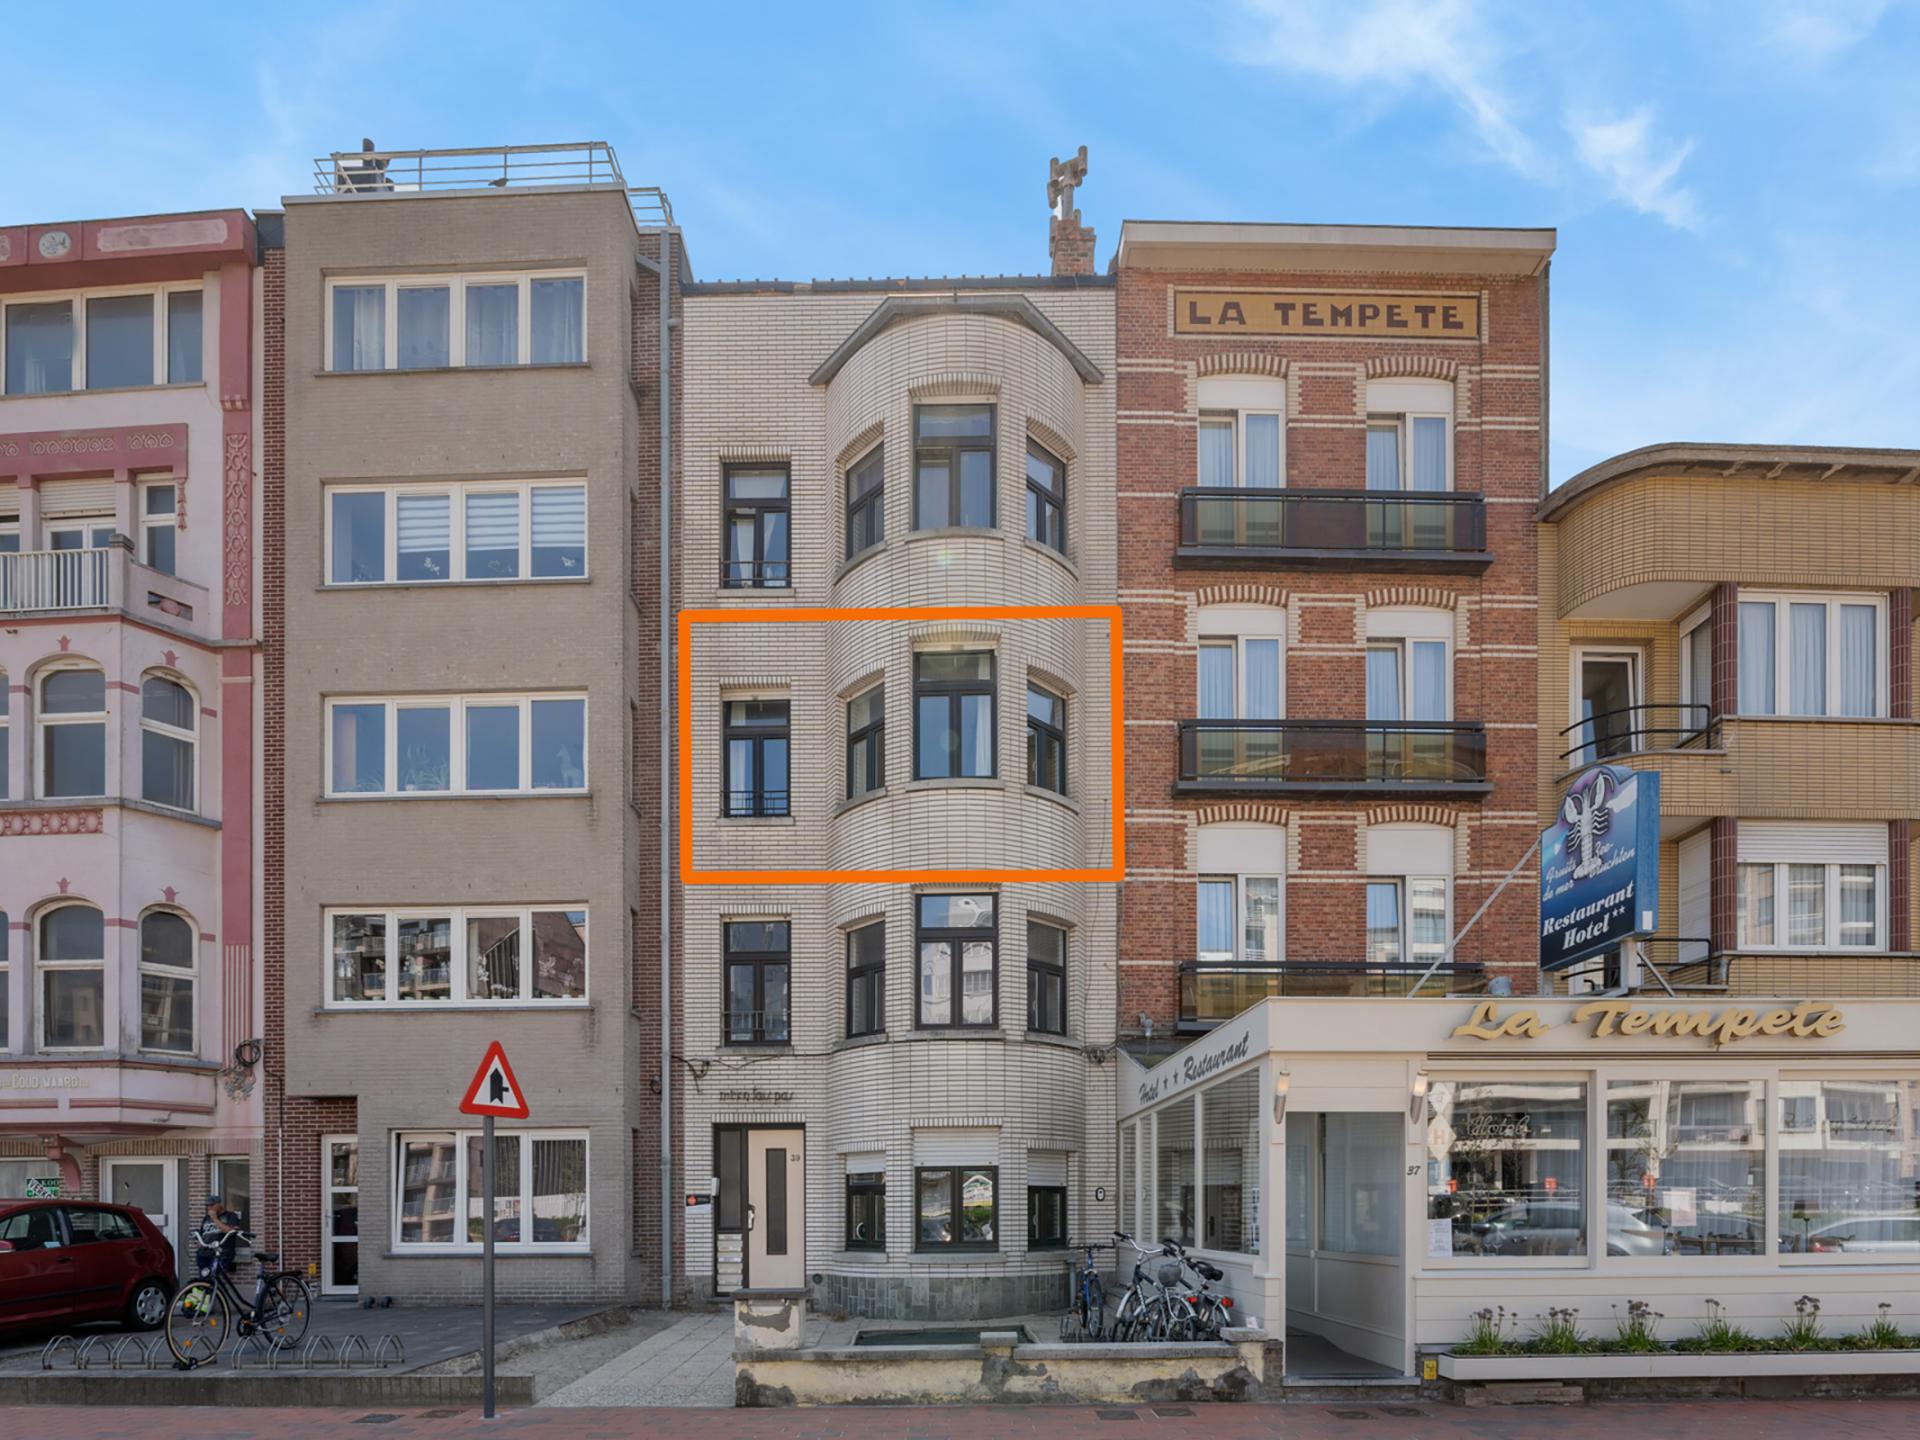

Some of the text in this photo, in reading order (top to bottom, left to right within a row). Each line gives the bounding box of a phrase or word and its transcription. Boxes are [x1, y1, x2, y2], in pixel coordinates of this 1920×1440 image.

[1188, 301, 1465, 329] LA TEMPETE
[1542, 880, 1635, 937] Restaurant
[1562, 912, 1610, 950] Hotel
[1450, 1000, 1847, 1046] La Tempete
[1138, 1031, 1250, 1105] Hotel Restaurant
[1466, 1115, 1531, 1137] Hotel
[1406, 1165, 1421, 1175] 37
